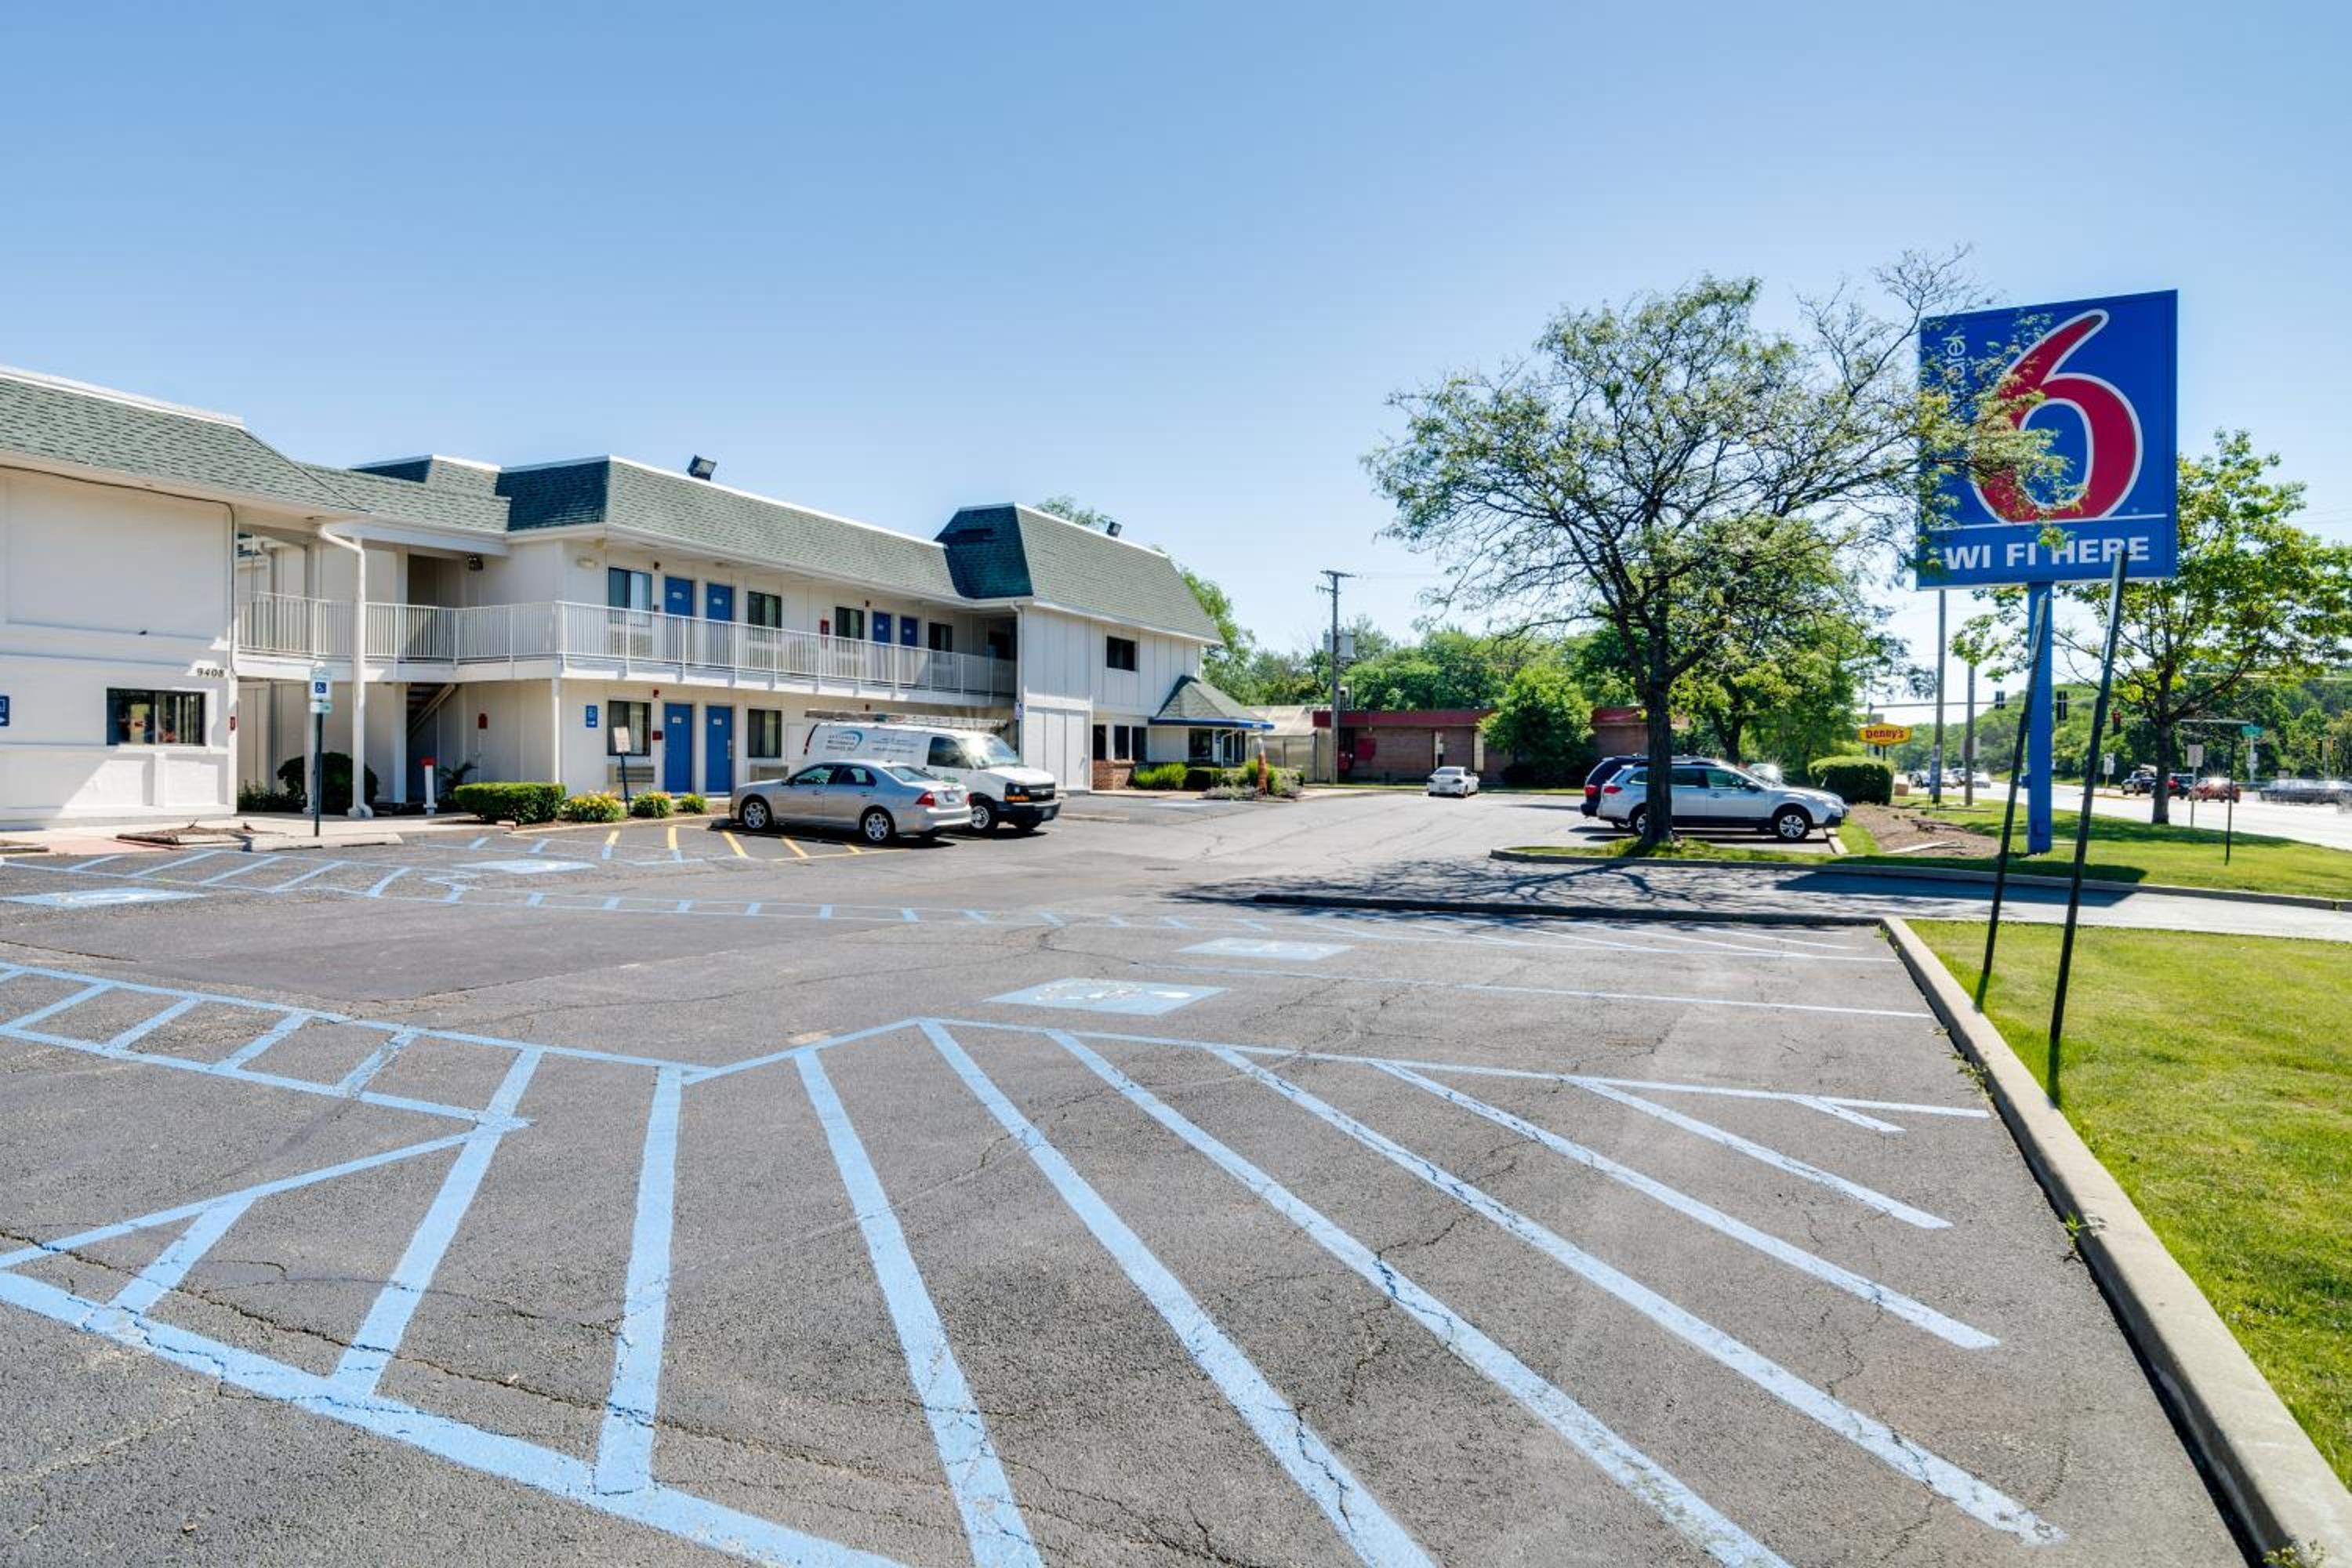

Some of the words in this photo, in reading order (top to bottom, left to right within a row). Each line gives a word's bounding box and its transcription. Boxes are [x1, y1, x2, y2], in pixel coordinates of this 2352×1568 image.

[1971, 308, 2143, 524] 6
[1945, 545, 1991, 570] WI
[2006, 543, 2036, 567] FI
[2051, 537, 2150, 565] HERE
